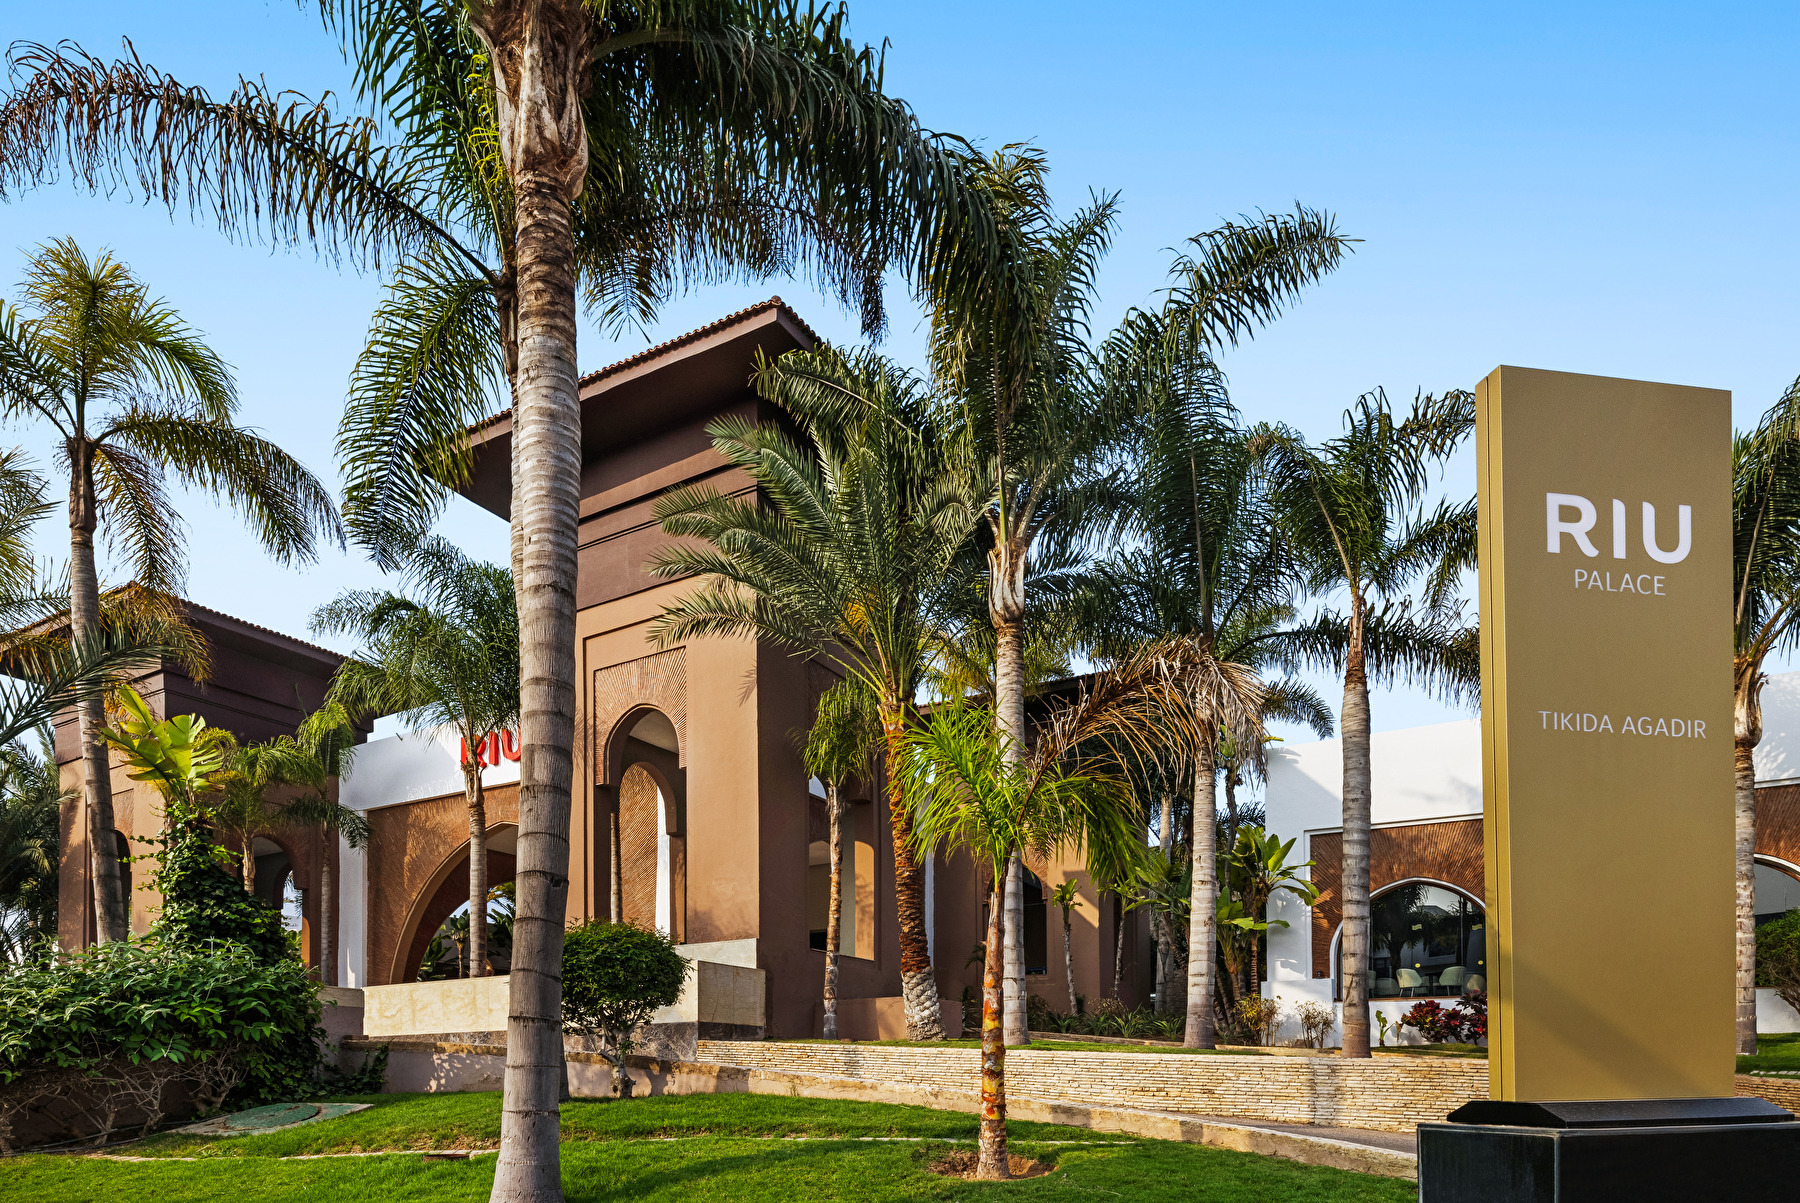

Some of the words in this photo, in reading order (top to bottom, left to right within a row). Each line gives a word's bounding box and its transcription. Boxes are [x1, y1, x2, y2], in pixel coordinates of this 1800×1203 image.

[1546, 492, 1692, 564] RIU
[1574, 569, 1666, 596] PALACE
[1538, 710, 1614, 734] TIKIDA
[1621, 715, 1707, 739] AGADIR
